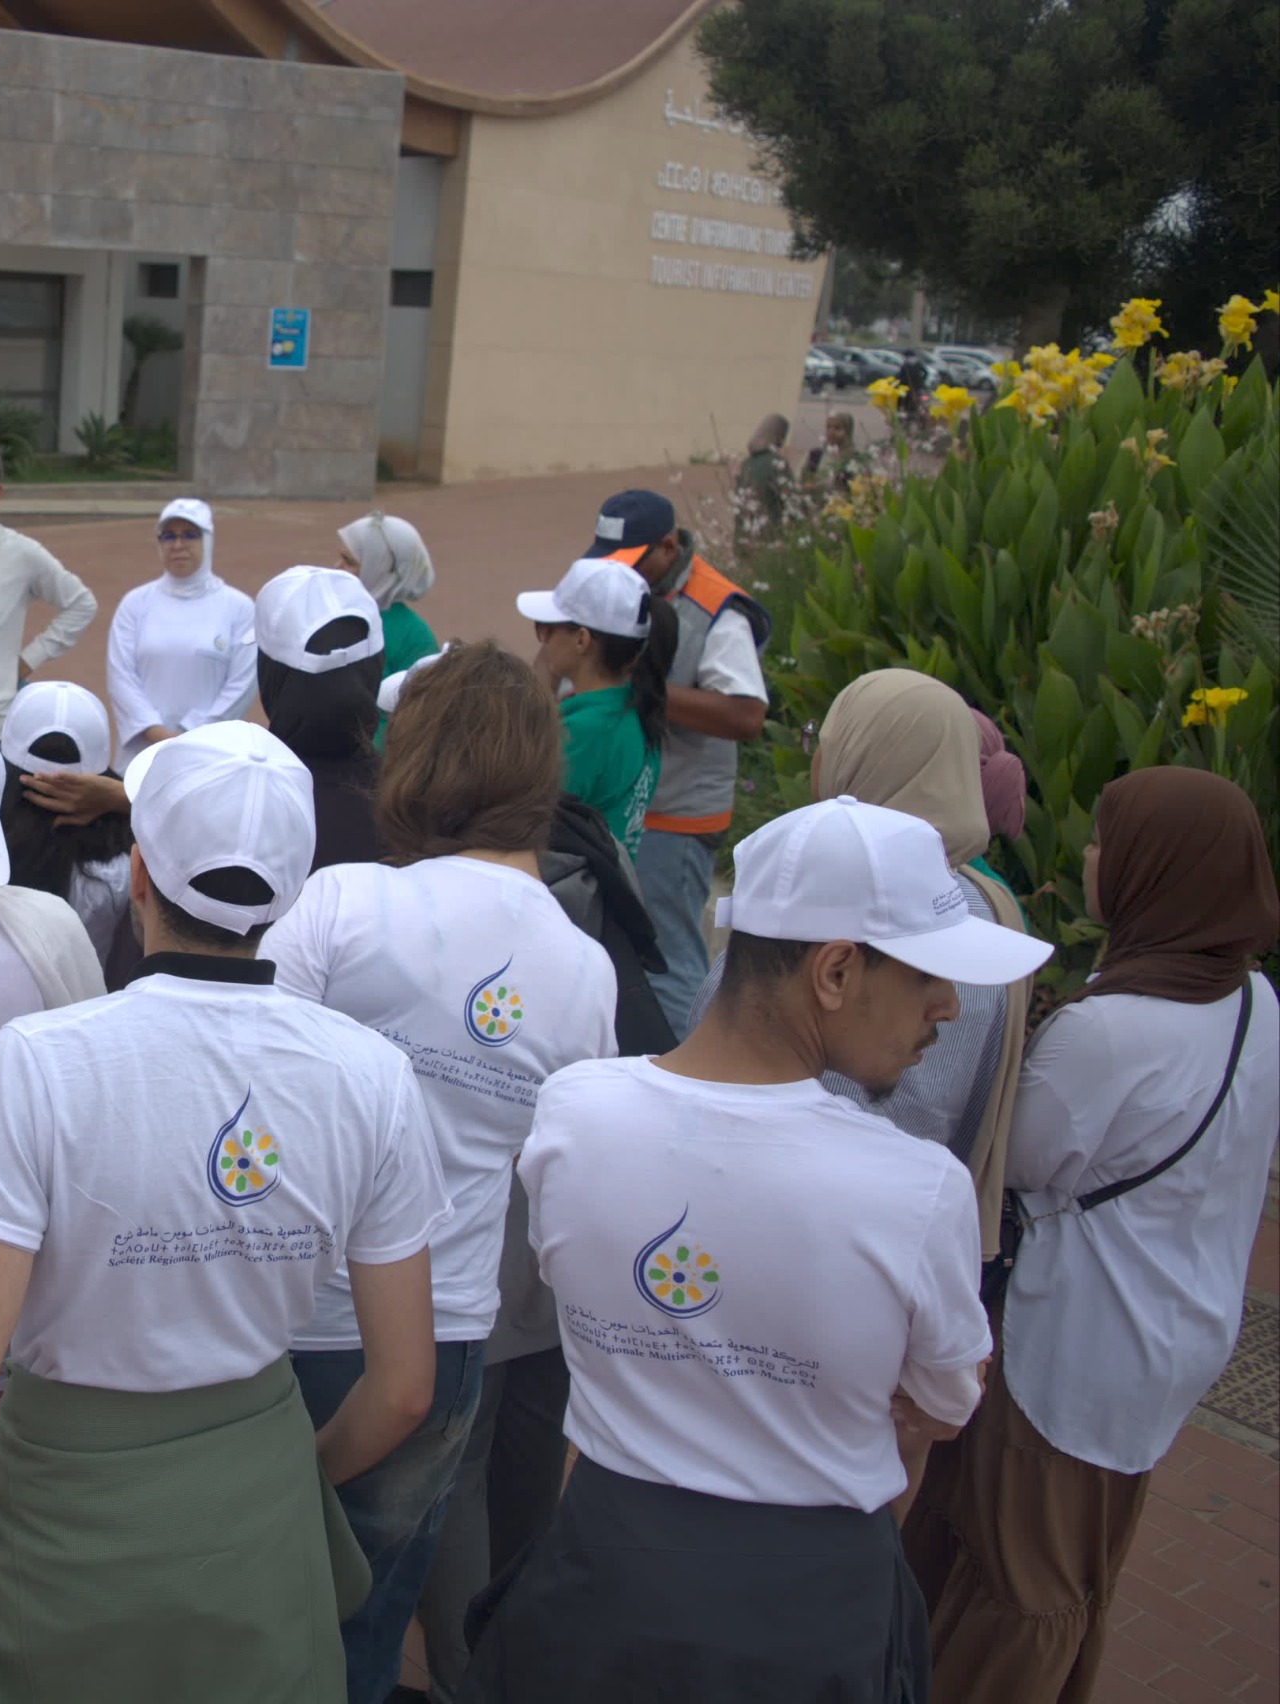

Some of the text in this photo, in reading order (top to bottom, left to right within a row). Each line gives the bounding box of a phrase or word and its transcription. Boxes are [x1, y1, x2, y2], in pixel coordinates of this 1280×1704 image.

[439, 1073, 492, 1097] Multiservices
[108, 1255, 146, 1267] Société
[149, 1254, 201, 1266] Régionale
[203, 1248, 263, 1264] Multiservices
[631, 1324, 679, 1337] الخدمات
[595, 1340, 645, 1359] Régionale
[727, 1338, 769, 1356] الجهوية
[772, 1348, 819, 1370] الشركة
